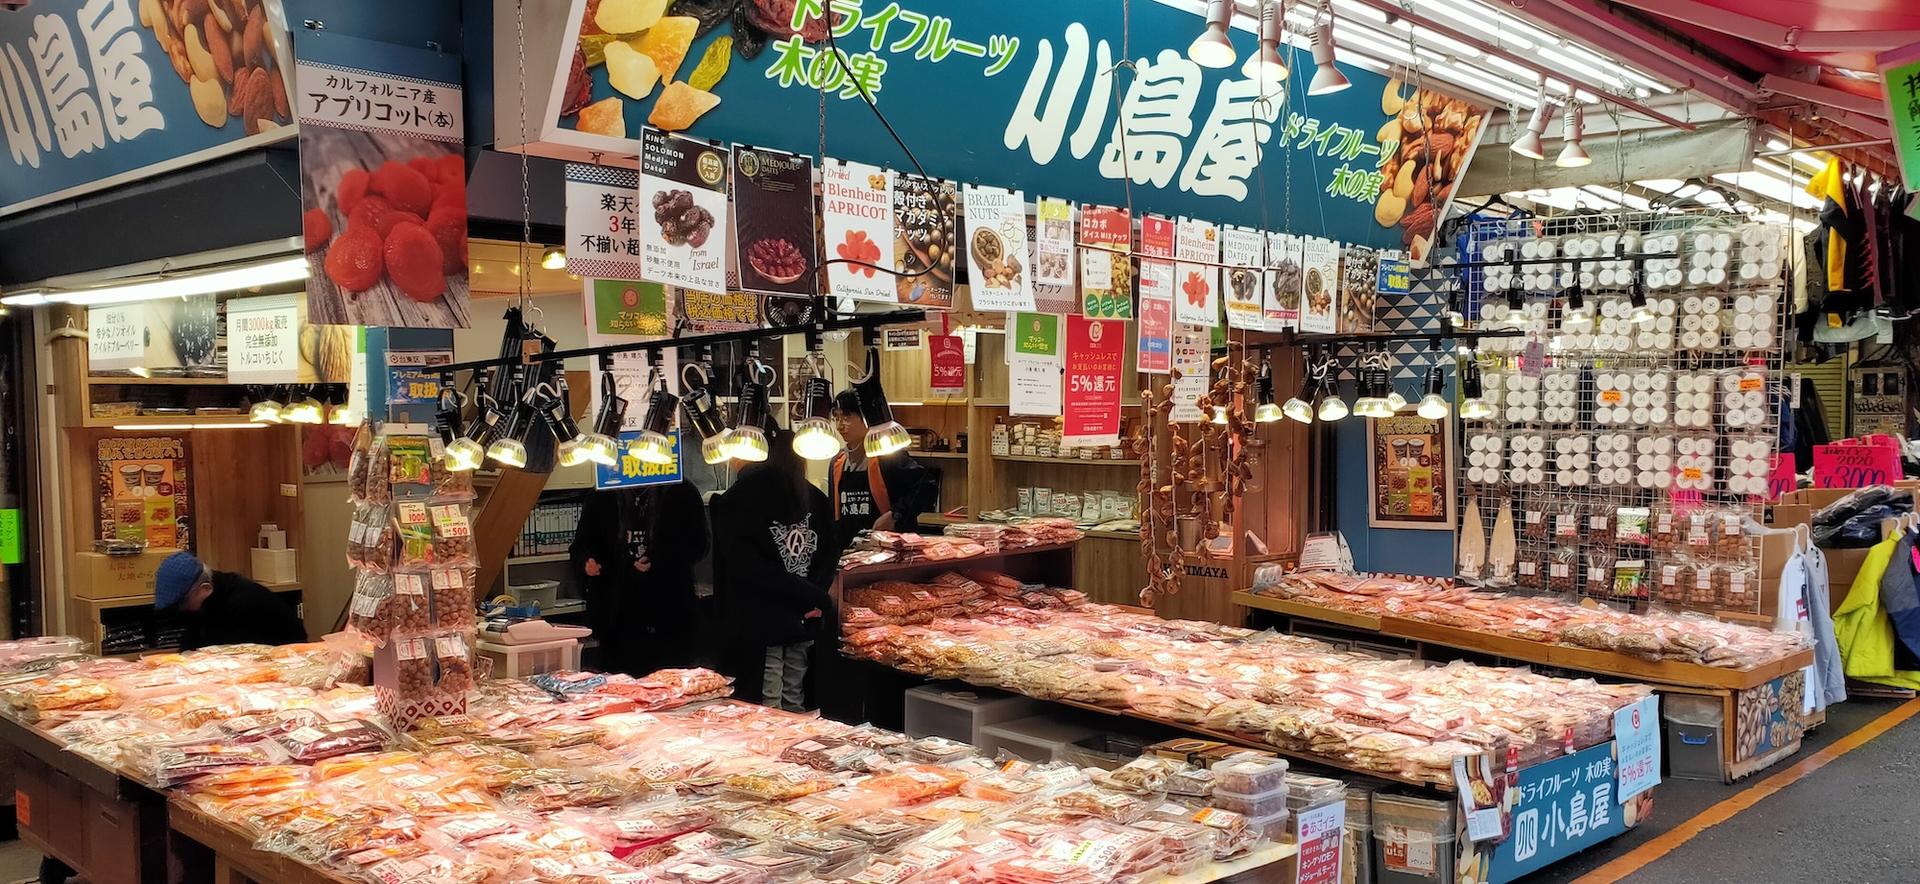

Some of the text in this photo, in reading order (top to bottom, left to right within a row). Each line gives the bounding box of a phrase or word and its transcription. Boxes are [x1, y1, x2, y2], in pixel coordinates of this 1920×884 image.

[789, 0, 1019, 77] ドライフルーツ
[766, 38, 887, 103] 木の実
[0, 0, 165, 168] 小島屋
[325, 74, 436, 104] カルフォルニア産
[308, 93, 454, 130] アプリコット(杏)
[1004, 22, 1285, 201] 小島屋
[645, 133, 665, 144] KING
[1280, 113, 1399, 169] ドライフルーツ
[645, 144, 684, 159] SOLOMON
[644, 153, 677, 167] Medjoul
[644, 163, 667, 174] Dates
[827, 168, 850, 181] Dried
[894, 178, 955, 195] 割りやすいスット入り
[1326, 166, 1384, 204] 木の実
[828, 183, 887, 203] Blenheim
[894, 190, 927, 208] 殻付き
[968, 194, 1008, 206] BRAZIL
[828, 200, 887, 220] APRICOT
[969, 207, 1000, 220] NUTS
[609, 215, 639, 235] 3年
[1083, 218, 1107, 229] ロカボ
[895, 227, 927, 241] ナッツ
[1180, 235, 1215, 251] Blenheim
[1228, 241, 1258, 252] MEDJOUL
[1307, 242, 1329, 253] BRAZIL
[689, 249, 707, 259] from
[1179, 249, 1215, 262] APRICOT
[1228, 250, 1248, 260] DATES
[1307, 254, 1323, 263] NUTS
[692, 257, 719, 271] Israel
[240, 350, 283, 365] トルコいちじく
[1072, 352, 1117, 360] キャッシュレスで
[1071, 374, 1115, 392] 5%還元
[453, 527, 468, 536] 500
[1162, 563, 1228, 578] KIMAYA
[1518, 757, 1611, 806] ドライフルーツ 木の実
[1541, 782, 1611, 847] 小島屋
